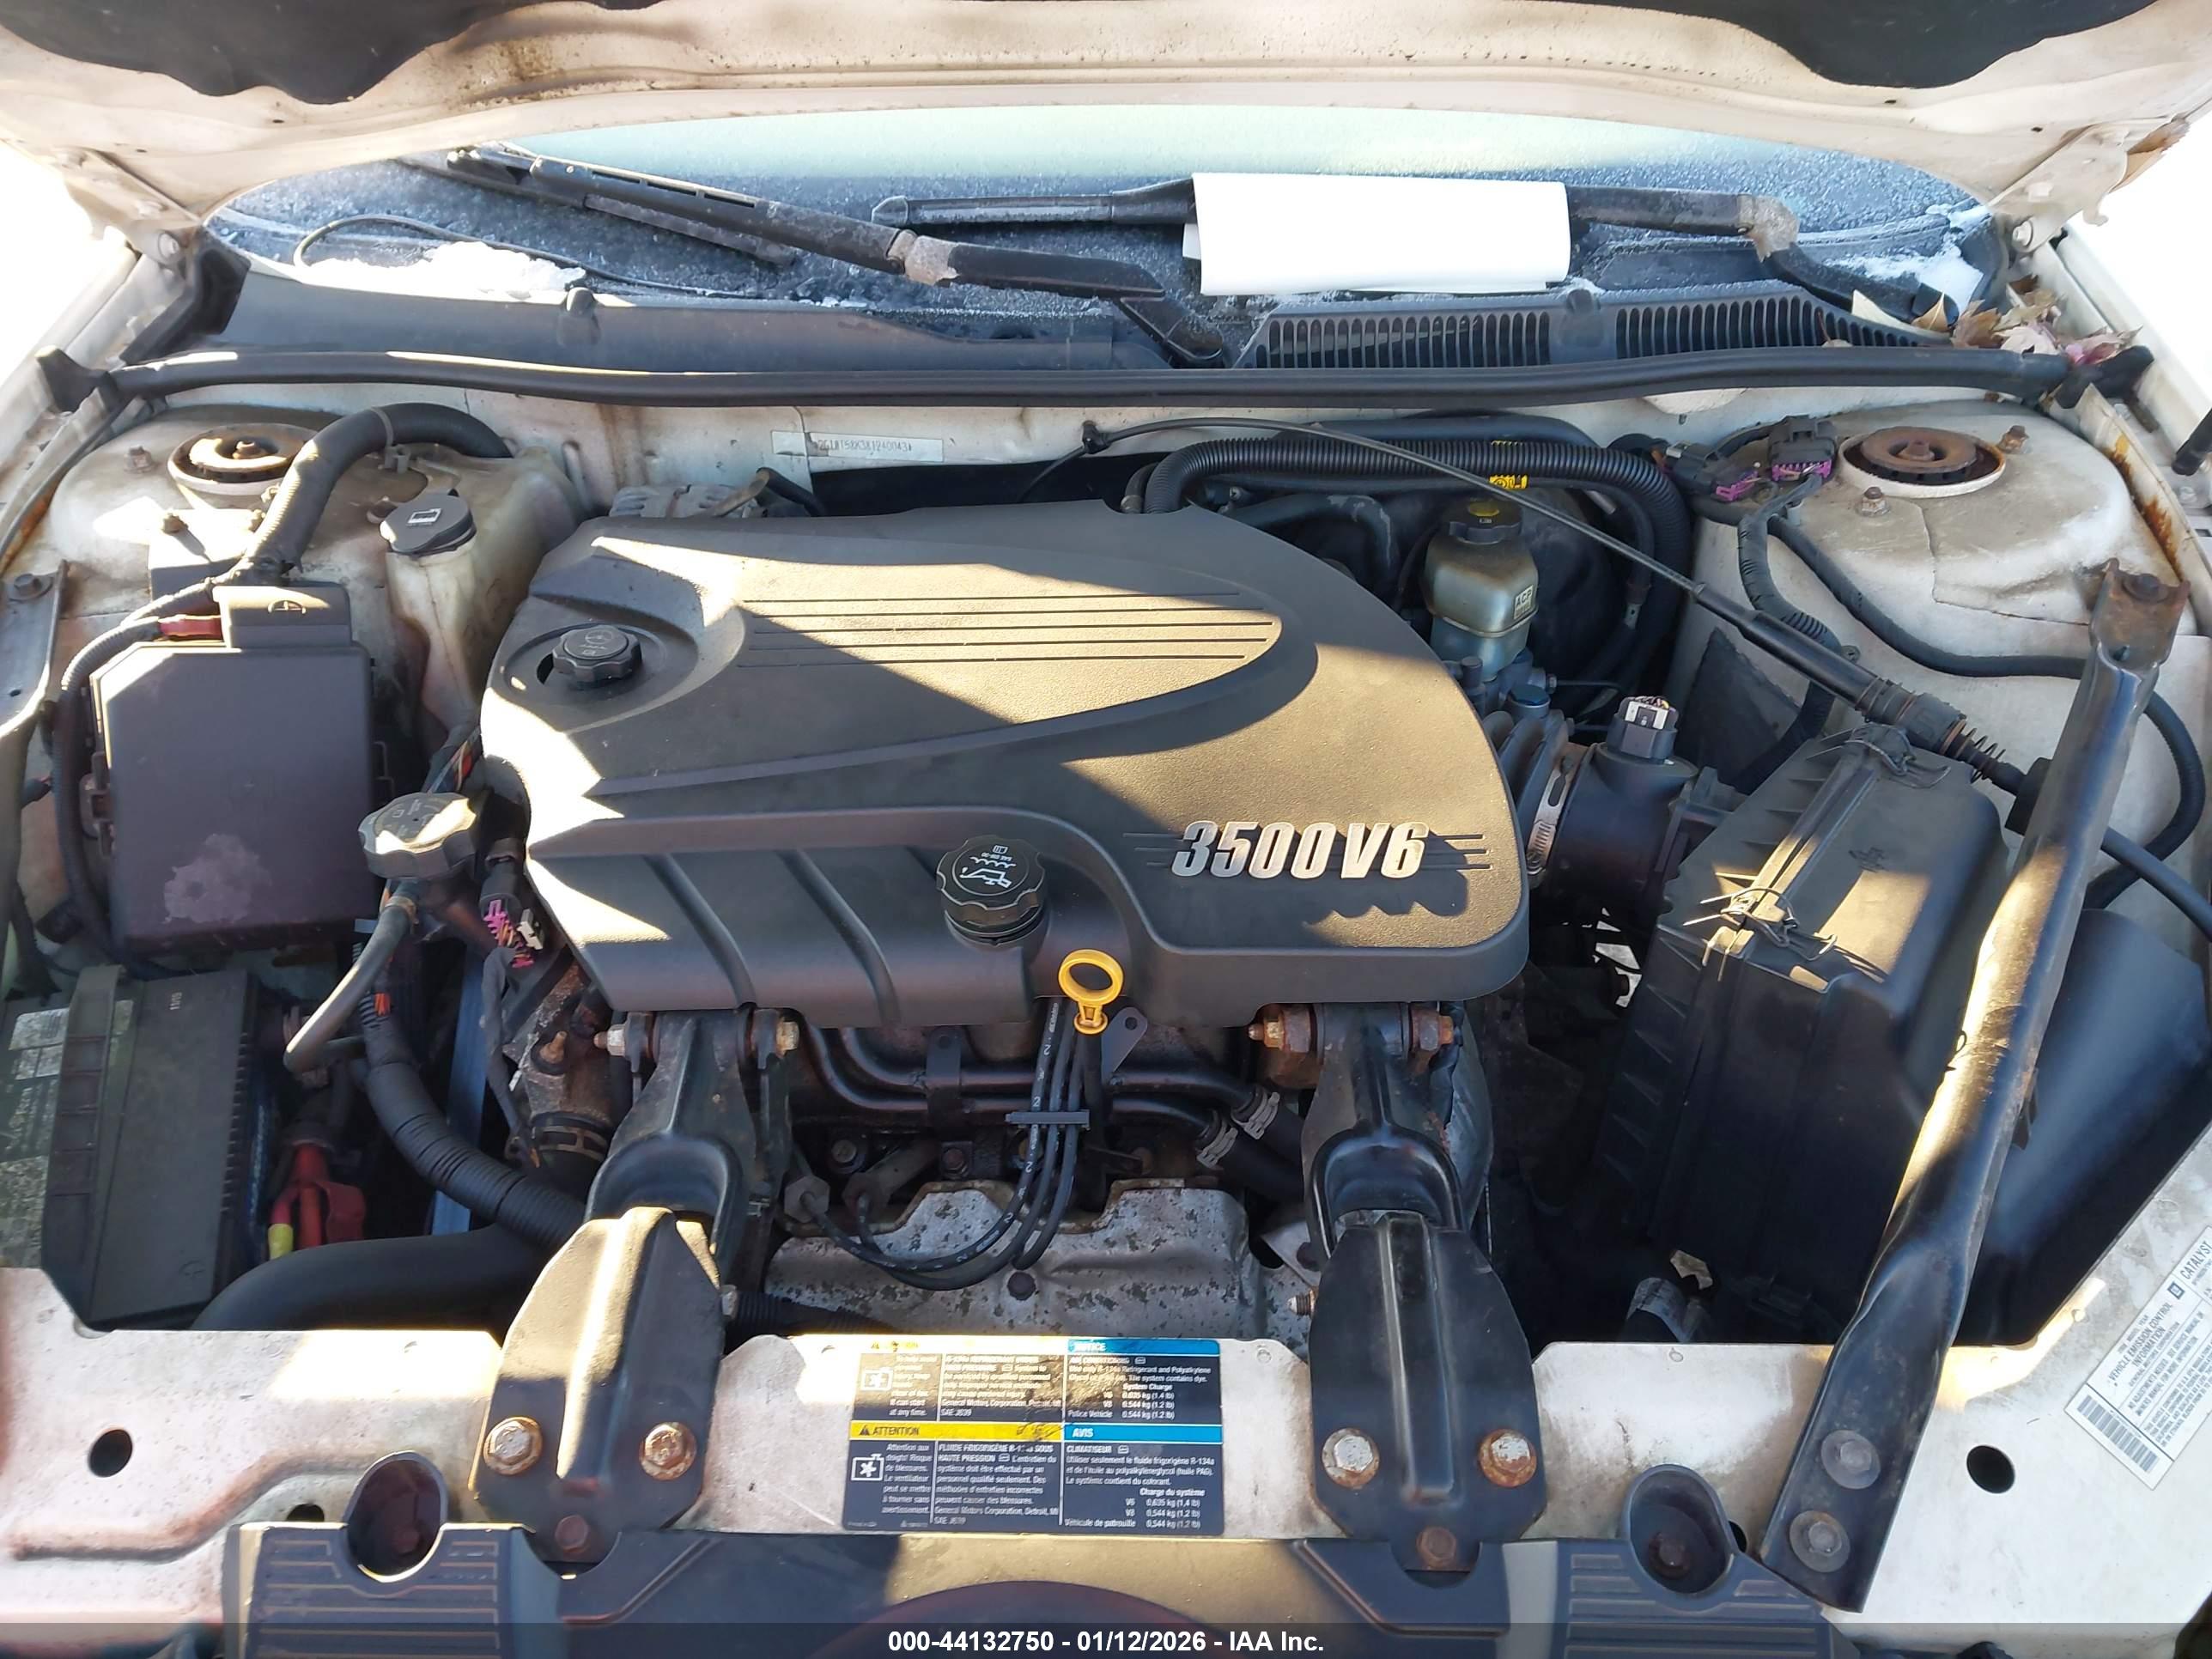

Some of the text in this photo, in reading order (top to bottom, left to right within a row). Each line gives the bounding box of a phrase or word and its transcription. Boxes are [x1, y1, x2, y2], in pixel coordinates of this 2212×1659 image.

[1171, 821, 1431, 879] 3500 V6
[1033, 1097, 1041, 1106] 2
[1005, 1212, 1013, 1223] 2
[2179, 1239, 2212, 1279] CATALYST
[2107, 1354, 2131, 1382] VEHICLE
[2126, 1326, 2153, 1357] EMISSION
[2148, 1300, 2172, 1329] CONTROL
[2130, 1325, 2166, 1367] INFORMATION
[1143, 1411, 1151, 1419] kg
[873, 1427, 920, 1436] ATTENTION
[1073, 1429, 1093, 1437] AVIS
[1167, 1510, 1176, 1518] kg
[1167, 1521, 1176, 1529] kg
